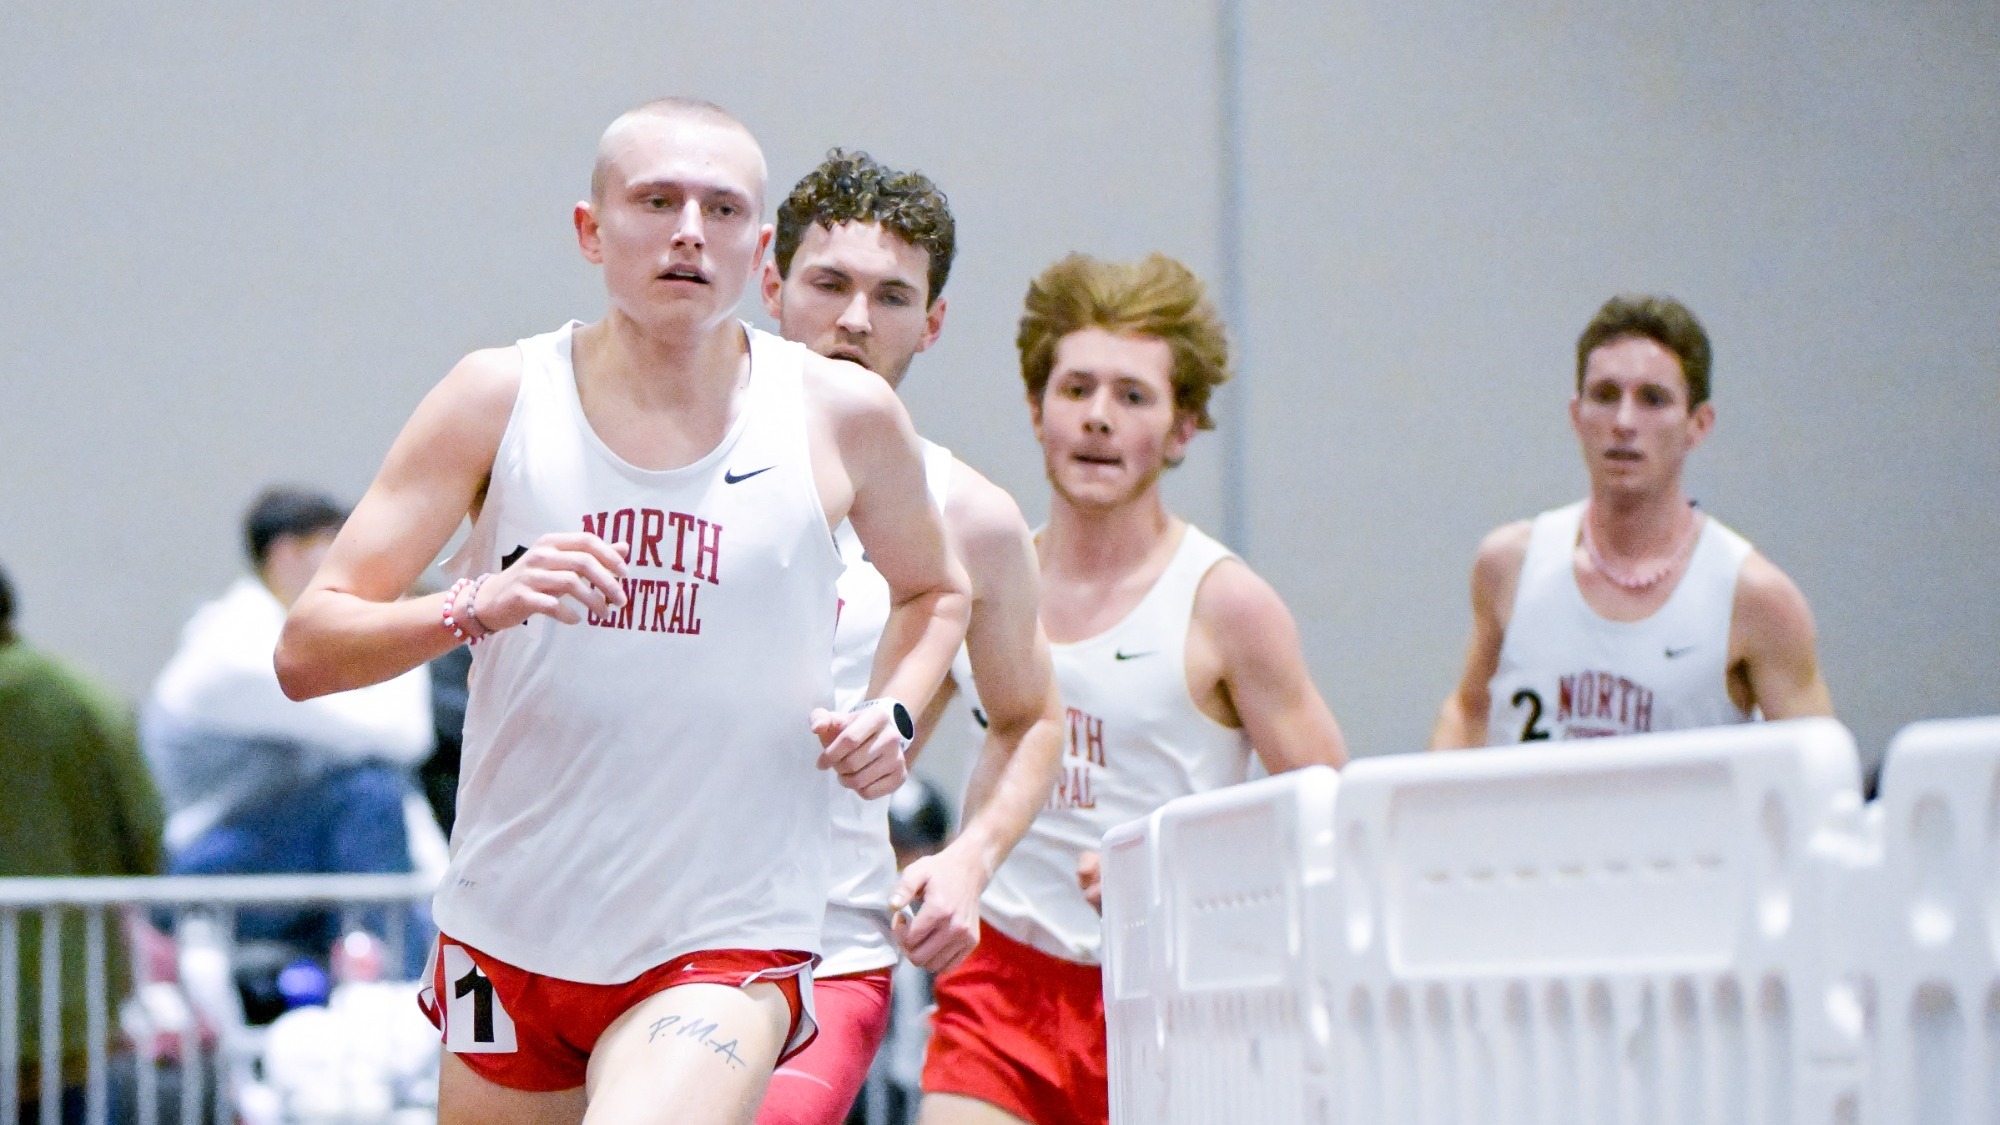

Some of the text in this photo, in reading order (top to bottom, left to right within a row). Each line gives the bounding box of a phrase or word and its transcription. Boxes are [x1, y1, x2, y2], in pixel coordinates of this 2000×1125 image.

[1511, 688, 1551, 742] 2
[1557, 670, 1653, 732] NORTH
[455, 963, 494, 1042] 1
